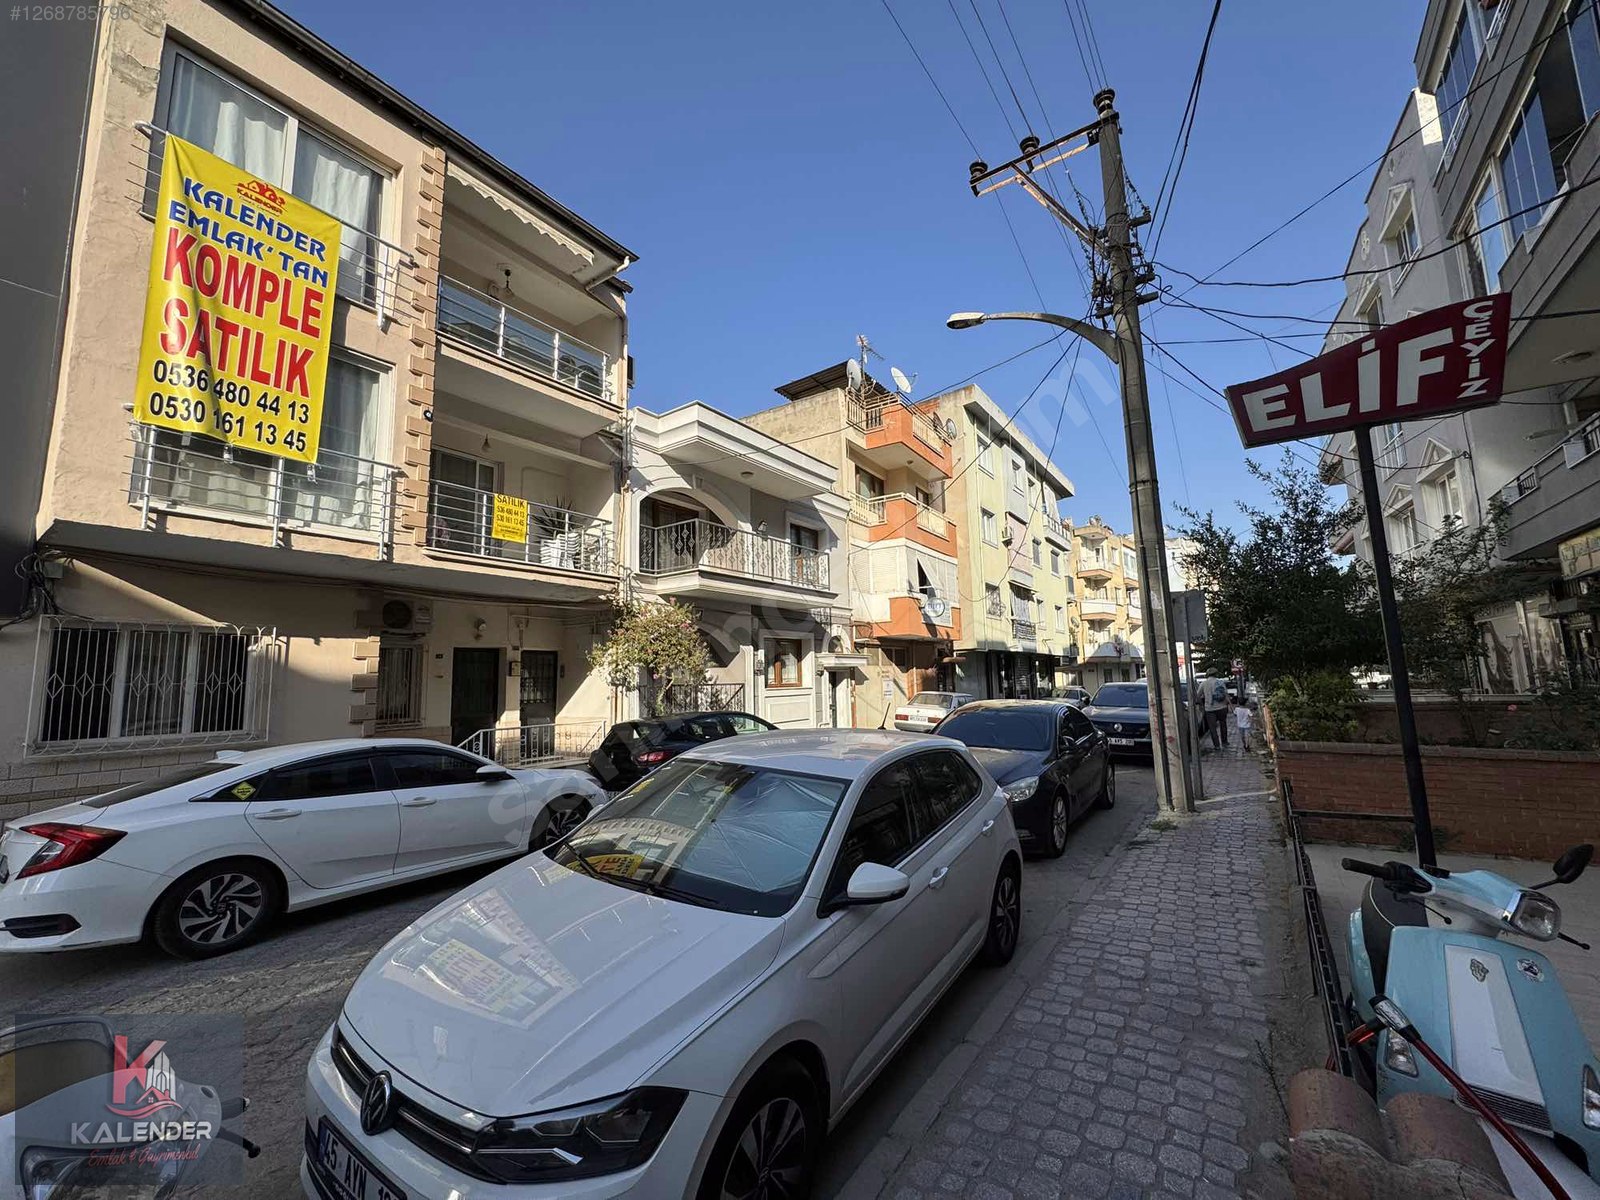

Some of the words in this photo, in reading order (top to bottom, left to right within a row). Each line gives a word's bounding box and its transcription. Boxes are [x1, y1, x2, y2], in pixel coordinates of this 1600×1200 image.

[184, 177, 326, 262] KALENDER
[163, 227, 324, 339] KOMPLE
[159, 298, 314, 398] SATILIK
[1242, 327, 1454, 433] ELİF
[149, 392, 206, 423] 0530
[213, 408, 245, 437] 161
[254, 420, 277, 445] 13
[283, 429, 306, 453] 45
[153, 359, 209, 392] 0536
[213, 378, 250, 407] 480
[256, 391, 281, 416] 44
[288, 400, 310, 424] 13
[497, 494, 525, 509] SATILIK
[344, 1153, 367, 1200] AYN
